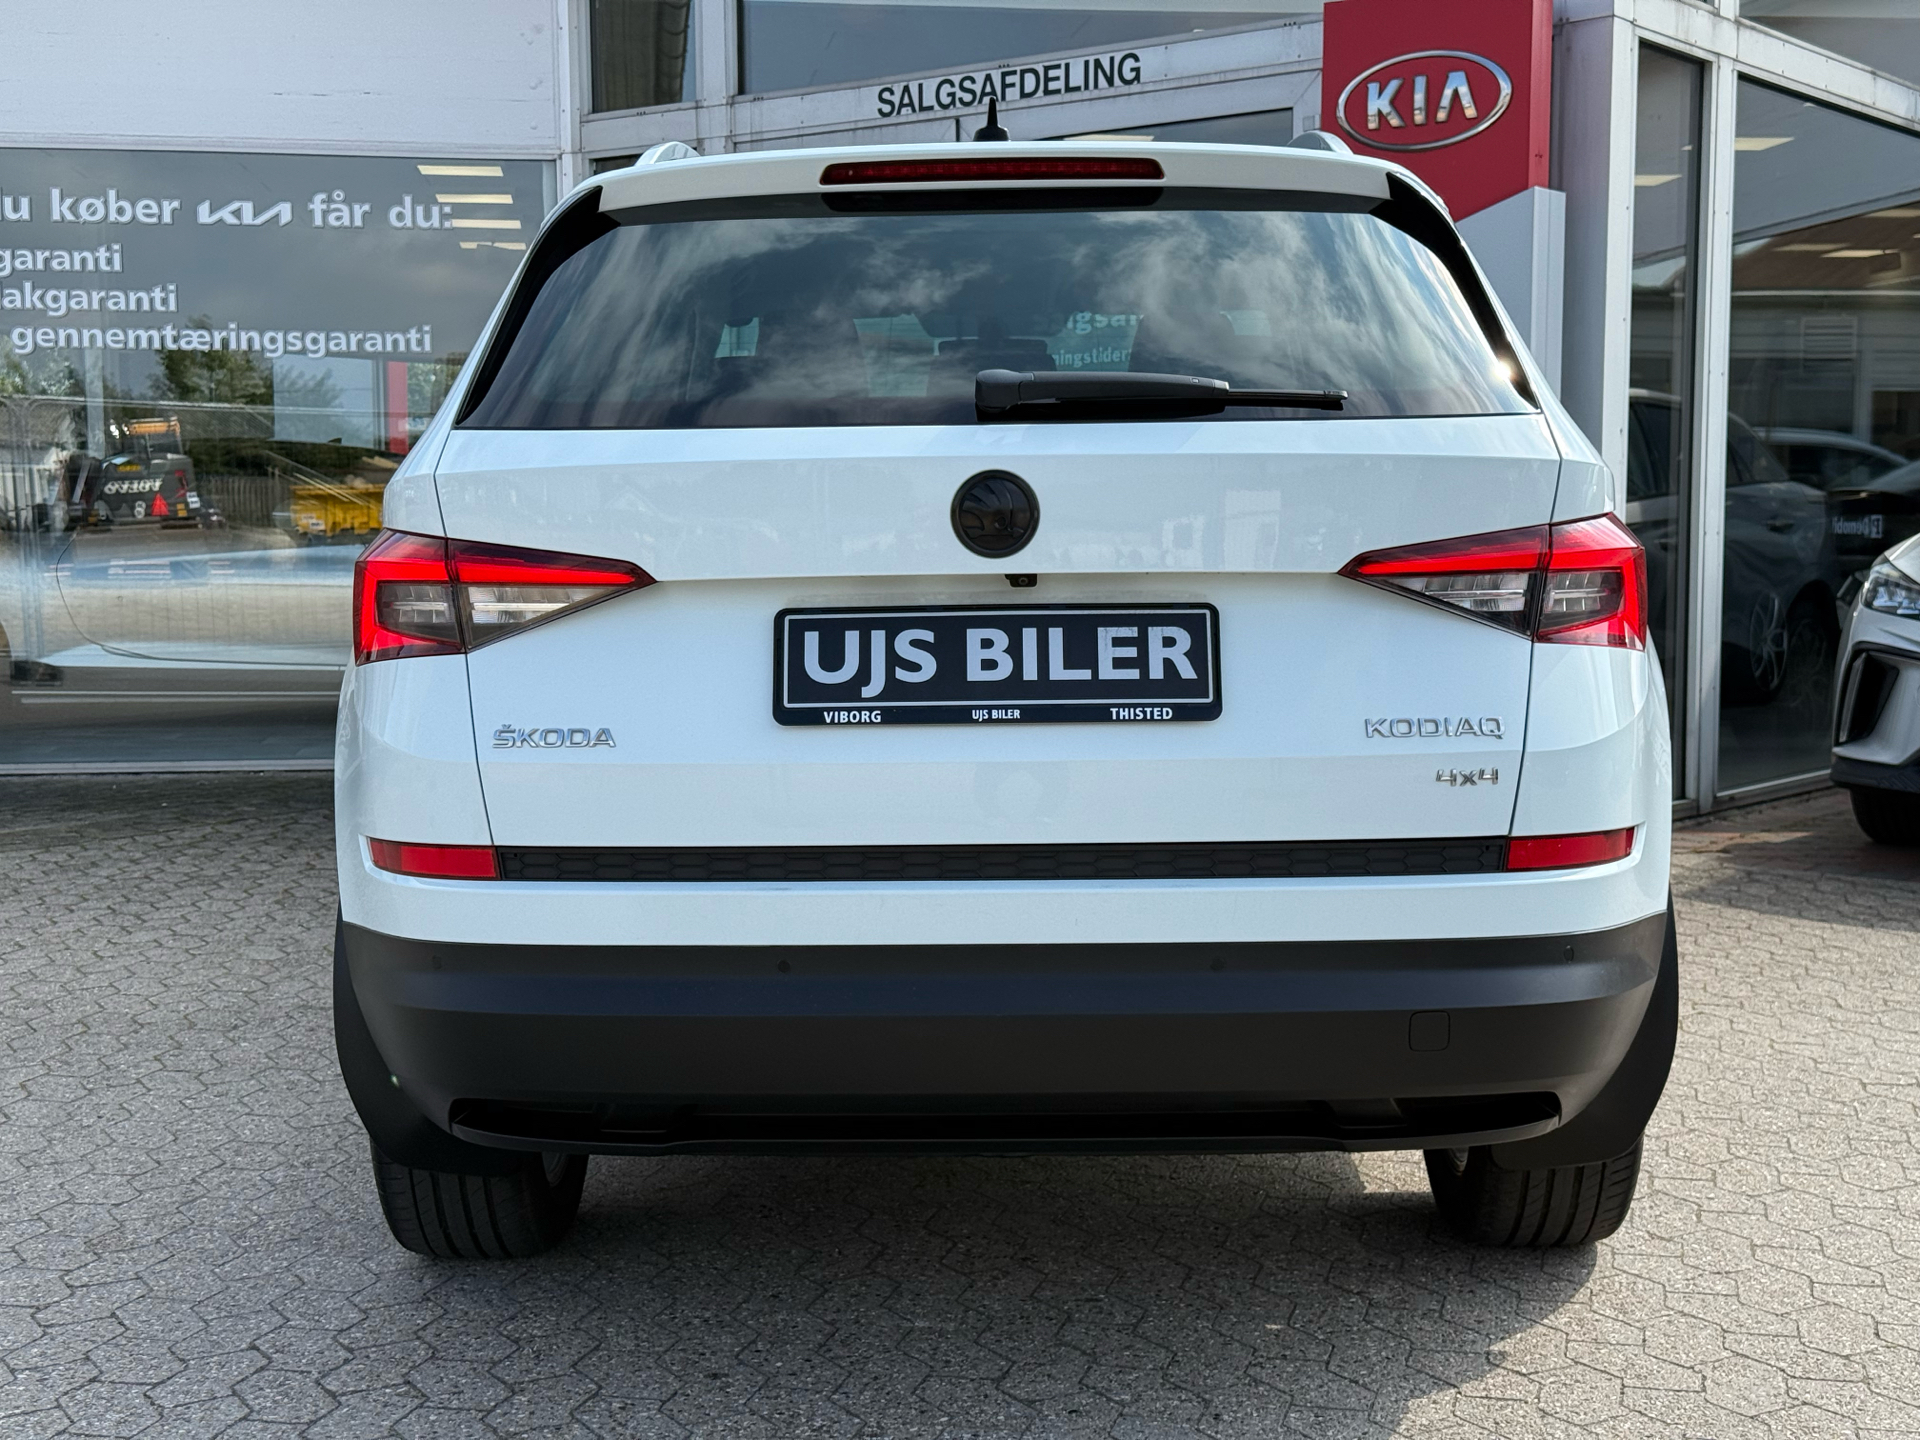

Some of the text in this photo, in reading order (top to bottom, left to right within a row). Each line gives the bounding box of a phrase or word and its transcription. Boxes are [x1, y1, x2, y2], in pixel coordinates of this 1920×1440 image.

[877, 52, 1141, 118] SALGSAFDELING
[1366, 70, 1478, 130] KIA
[0, 188, 31, 222] u
[50, 187, 180, 225] køber
[308, 189, 371, 229] får
[388, 194, 454, 230] du:
[0, 281, 178, 317] akgaranti
[11, 322, 433, 358] gennemtæringsgaranti
[803, 626, 1199, 698] UJS BILER
[823, 710, 882, 725] VIBORG
[971, 708, 1021, 722] UJS BILER
[1110, 707, 1173, 721] THISTED
[1364, 716, 1506, 739] KODIAQ
[492, 724, 617, 748] ŠKODA
[1435, 767, 1499, 787] 4x4
